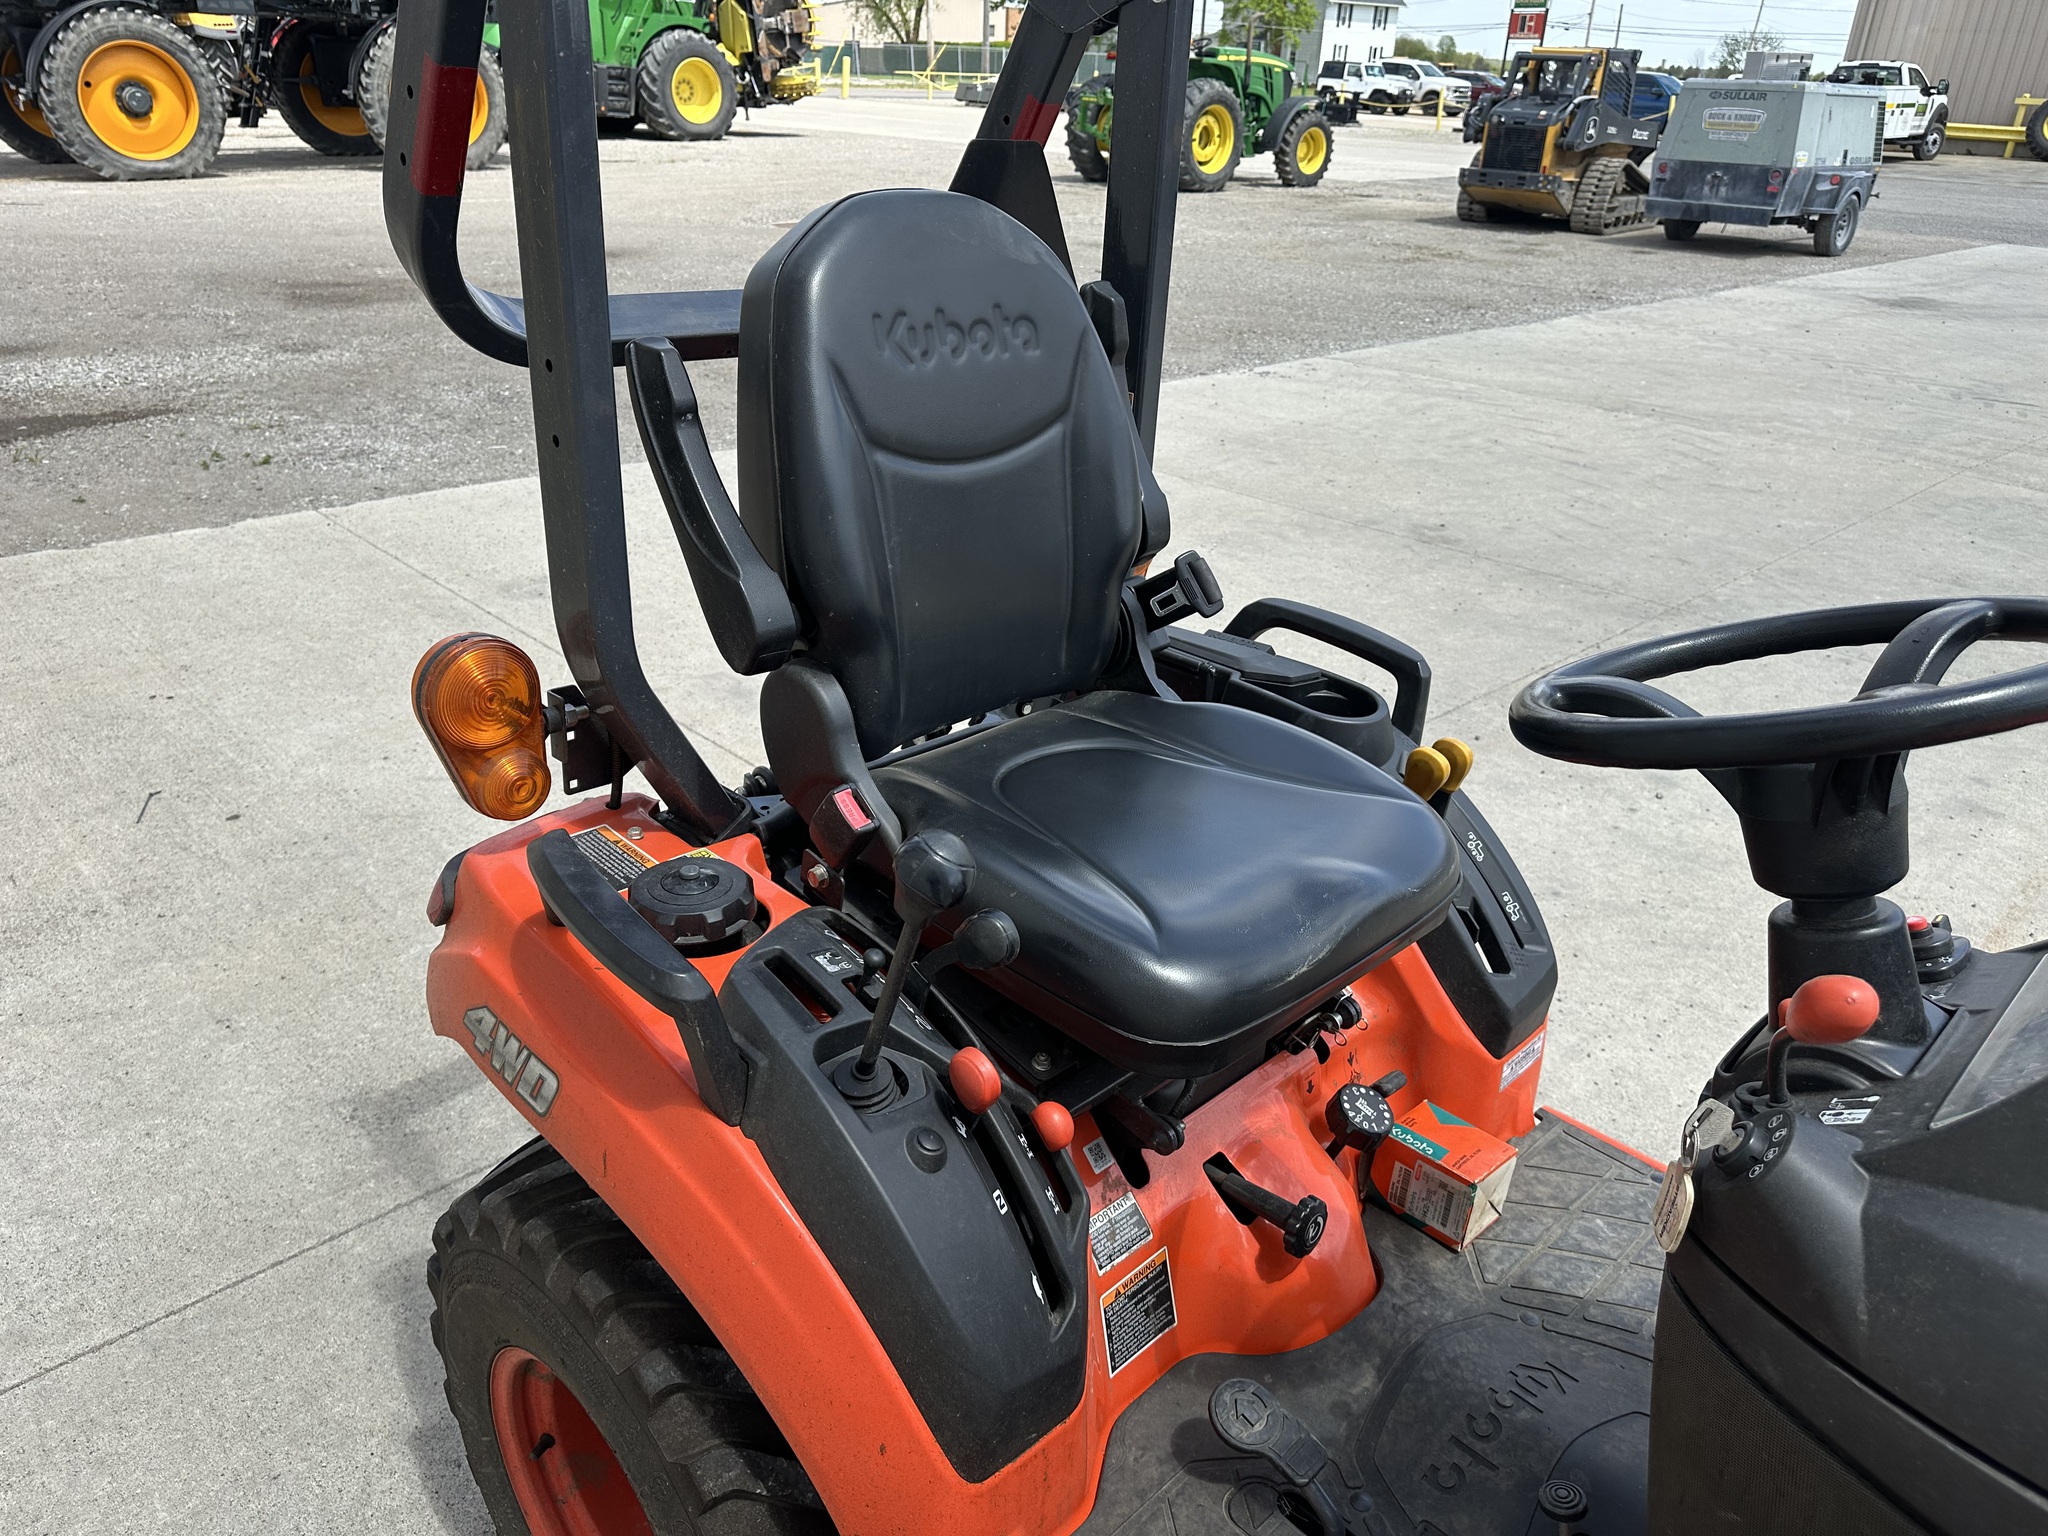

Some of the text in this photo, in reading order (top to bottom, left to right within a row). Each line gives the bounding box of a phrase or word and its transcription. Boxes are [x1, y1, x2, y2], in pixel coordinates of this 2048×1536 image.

[1722, 92, 1767, 101] SULLAIR
[872, 303, 1040, 368] Kubota
[841, 799, 857, 822] PRESS
[622, 841, 650, 864] WARNING
[463, 1006, 560, 1118] 4WD
[1391, 1126, 1434, 1155] Kubota
[995, 1194, 1005, 1210] N
[1088, 1198, 1128, 1232] MPORTANT
[1660, 1184, 1680, 1238] STREACKER
[1121, 1258, 1156, 1292] WARNING
[1125, 1275, 1147, 1297] PERSONAL
[1420, 1361, 1579, 1494] Kubota
